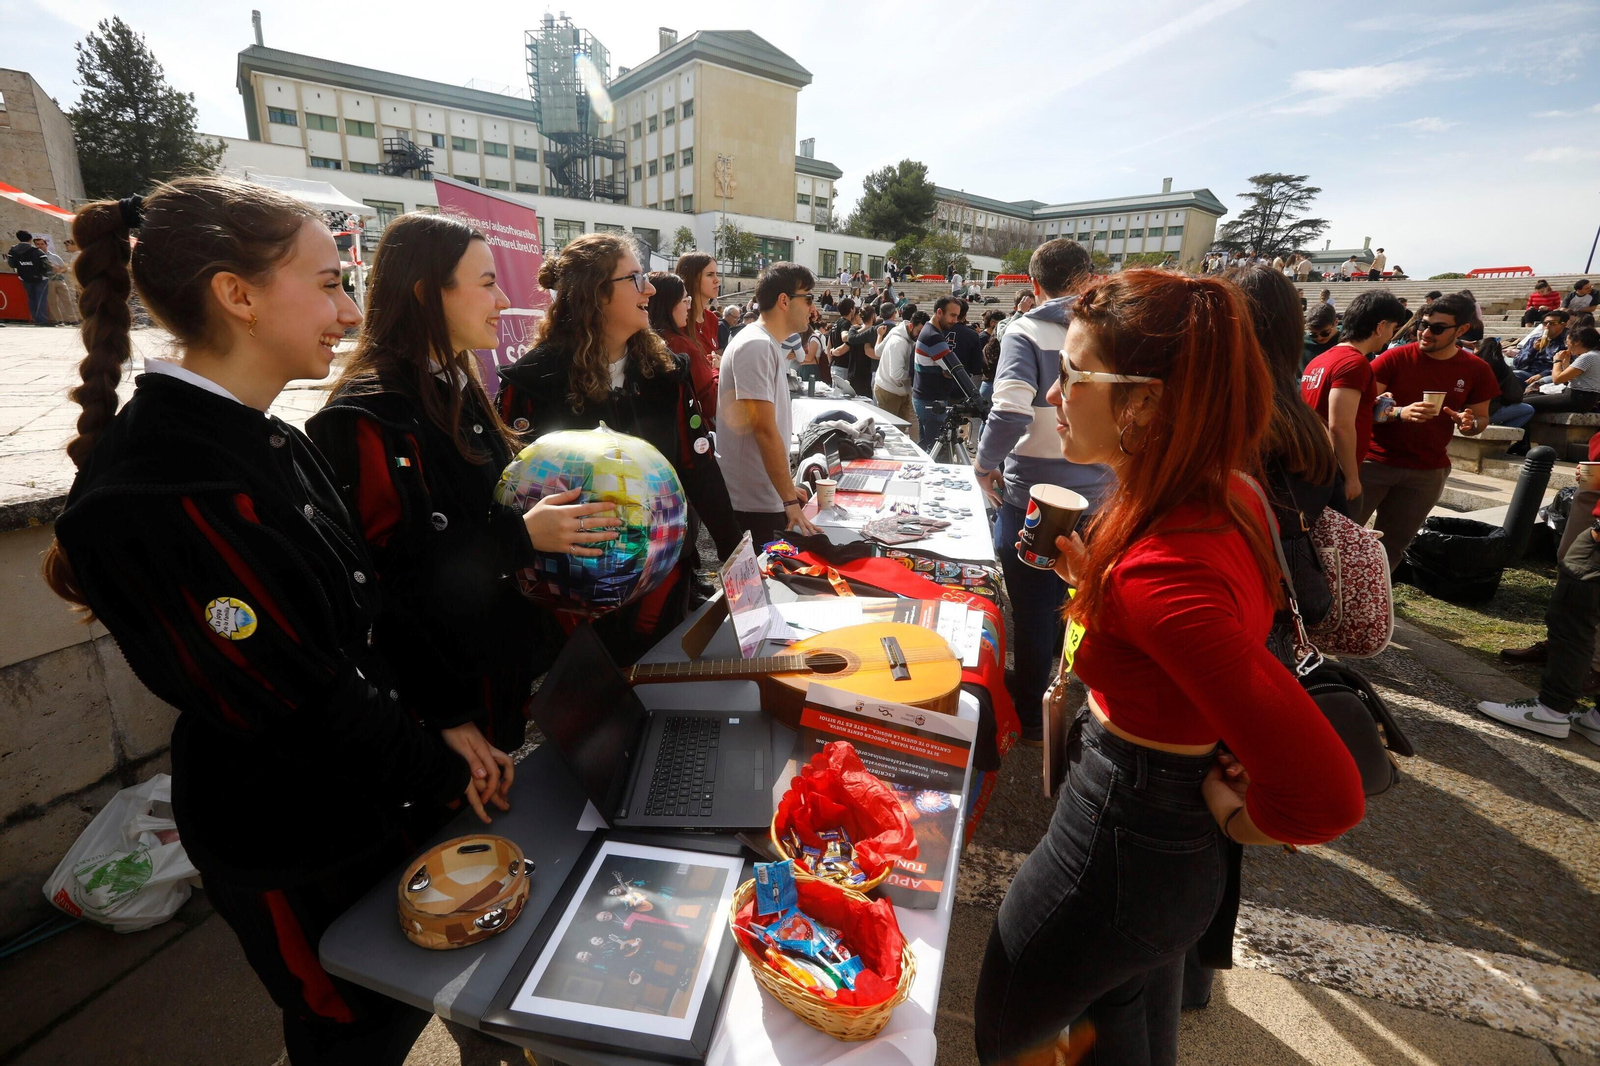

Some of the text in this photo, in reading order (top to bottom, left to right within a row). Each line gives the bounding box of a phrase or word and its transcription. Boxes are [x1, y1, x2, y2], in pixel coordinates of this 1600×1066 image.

[502, 319, 534, 343] AUL
[853, 724, 868, 732] ESTE
[864, 733, 889, 743] CONOCER
[901, 736, 918, 745] GUSTA
[909, 745, 926, 753] GUSTA
[931, 744, 952, 753] CANTAR
[884, 873, 923, 888] APÚ
